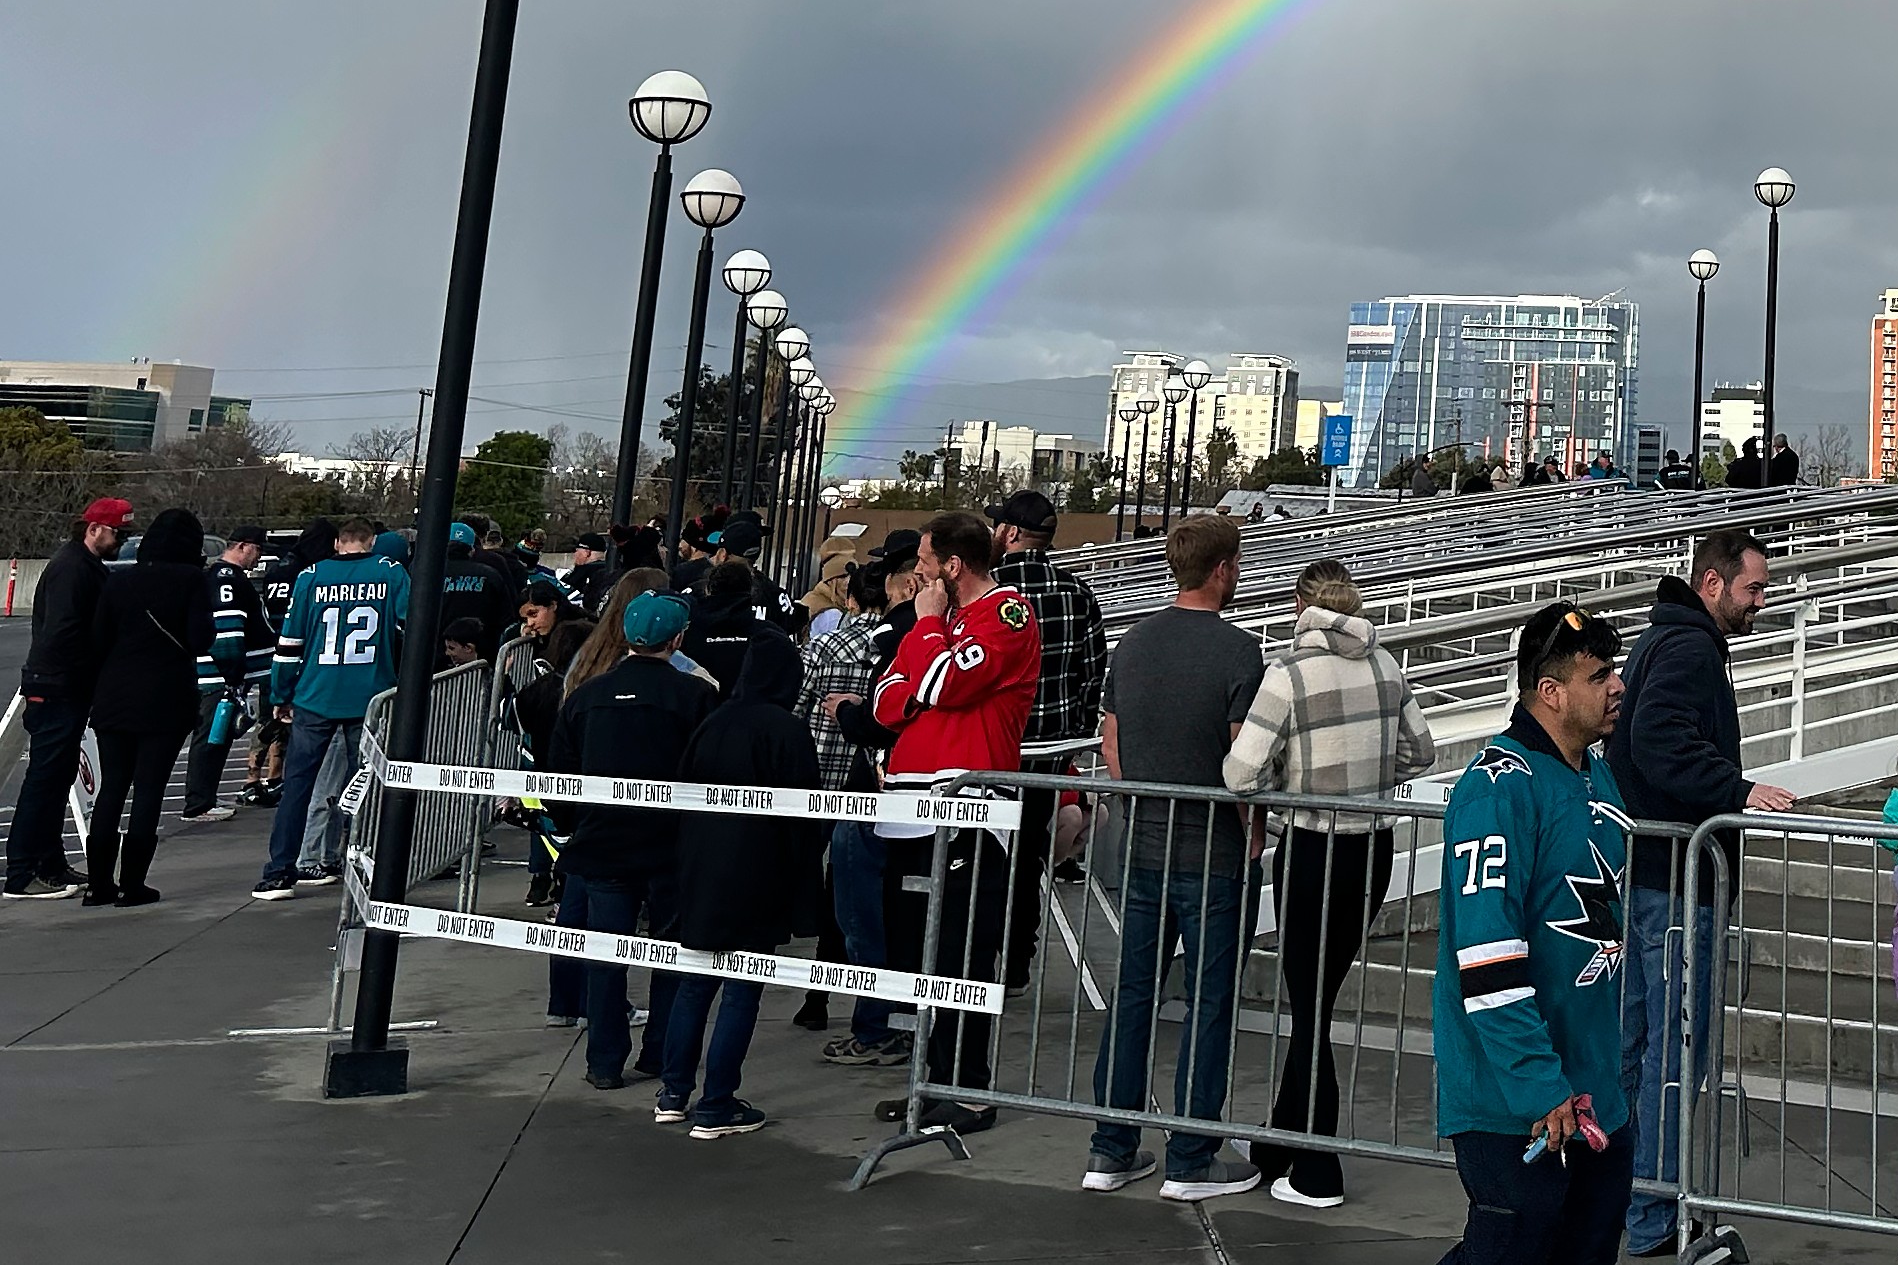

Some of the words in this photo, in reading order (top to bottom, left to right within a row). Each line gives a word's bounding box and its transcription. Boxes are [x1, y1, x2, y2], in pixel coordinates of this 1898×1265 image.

[220, 585, 233, 602] 6
[267, 583, 290, 599] 72
[315, 583, 387, 603] MARLEAU
[318, 606, 379, 665] 12
[387, 766, 412, 783] ENTER
[439, 769, 449, 785] DO
[452, 770, 468, 788] NOT
[469, 772, 494, 790] ENTER
[526, 775, 536, 792] DO
[539, 776, 555, 794] NOT
[557, 777, 582, 797] ENTER
[613, 781, 624, 799] DO
[626, 782, 643, 800] NOT
[645, 784, 672, 803] ENTER
[706, 788, 718, 805] DO
[721, 789, 740, 806] NOT
[743, 790, 773, 809] ENTER
[809, 794, 821, 812] DO
[823, 795, 844, 813] NOT
[846, 796, 877, 816] ENTER
[917, 799, 930, 818] DO
[933, 801, 953, 820] NOT
[956, 802, 989, 822] ENTER
[1454, 835, 1507, 896] 72
[383, 908, 409, 927] ENTER
[437, 914, 448, 932] DO
[451, 916, 467, 935] NOT
[469, 919, 495, 939] ENTER
[526, 926, 537, 944] DO
[539, 928, 556, 947] NOT
[558, 931, 586, 952] ENTER
[616, 939, 629, 958] DO
[631, 941, 648, 960] NOT
[649, 944, 677, 965] ENTER
[712, 951, 725, 970] DO
[727, 952, 745, 972] NOT
[747, 957, 776, 978] ENTER
[810, 965, 823, 984] DO
[825, 967, 844, 986] NOT
[846, 970, 876, 992] ENTER
[914, 978, 927, 998] DO
[930, 980, 951, 1001] NOT
[954, 984, 986, 1006] ENTER
